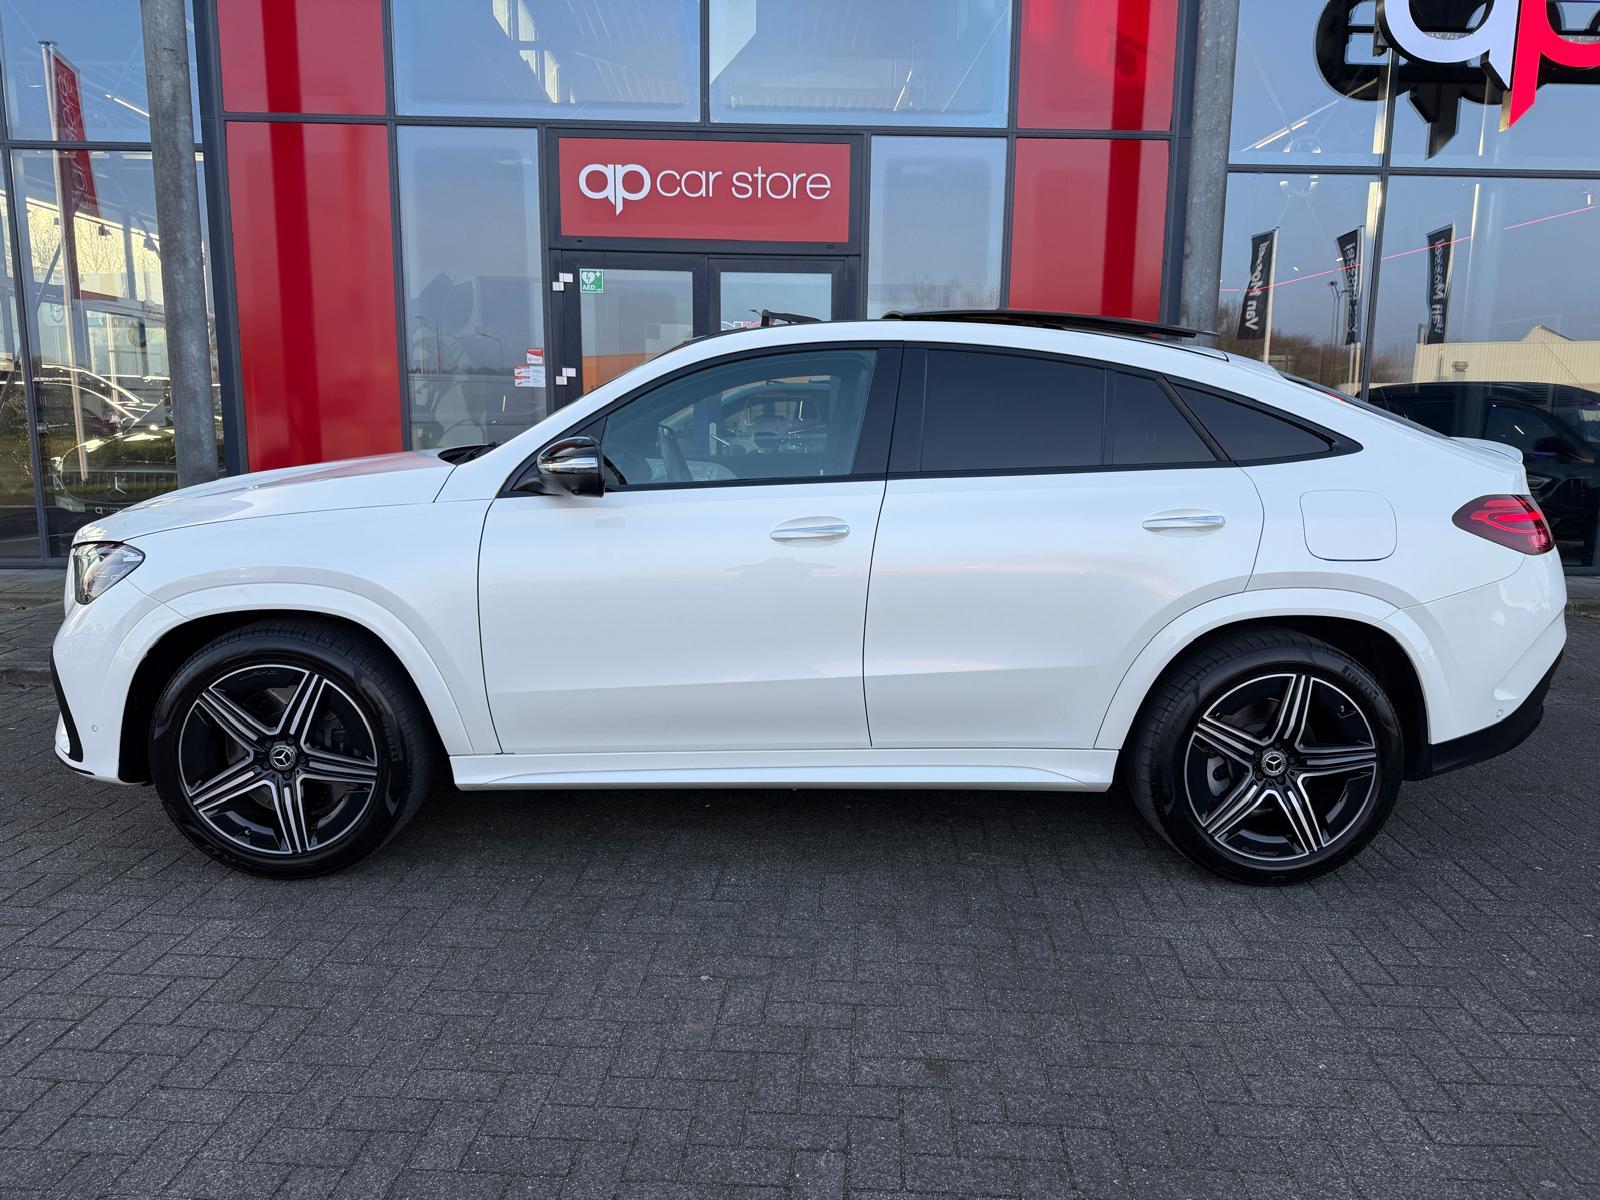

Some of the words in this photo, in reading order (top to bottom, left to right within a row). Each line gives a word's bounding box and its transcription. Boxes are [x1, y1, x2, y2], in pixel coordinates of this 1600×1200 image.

[578, 163, 651, 216] ap
[656, 169, 723, 198] car
[731, 166, 832, 200] store
